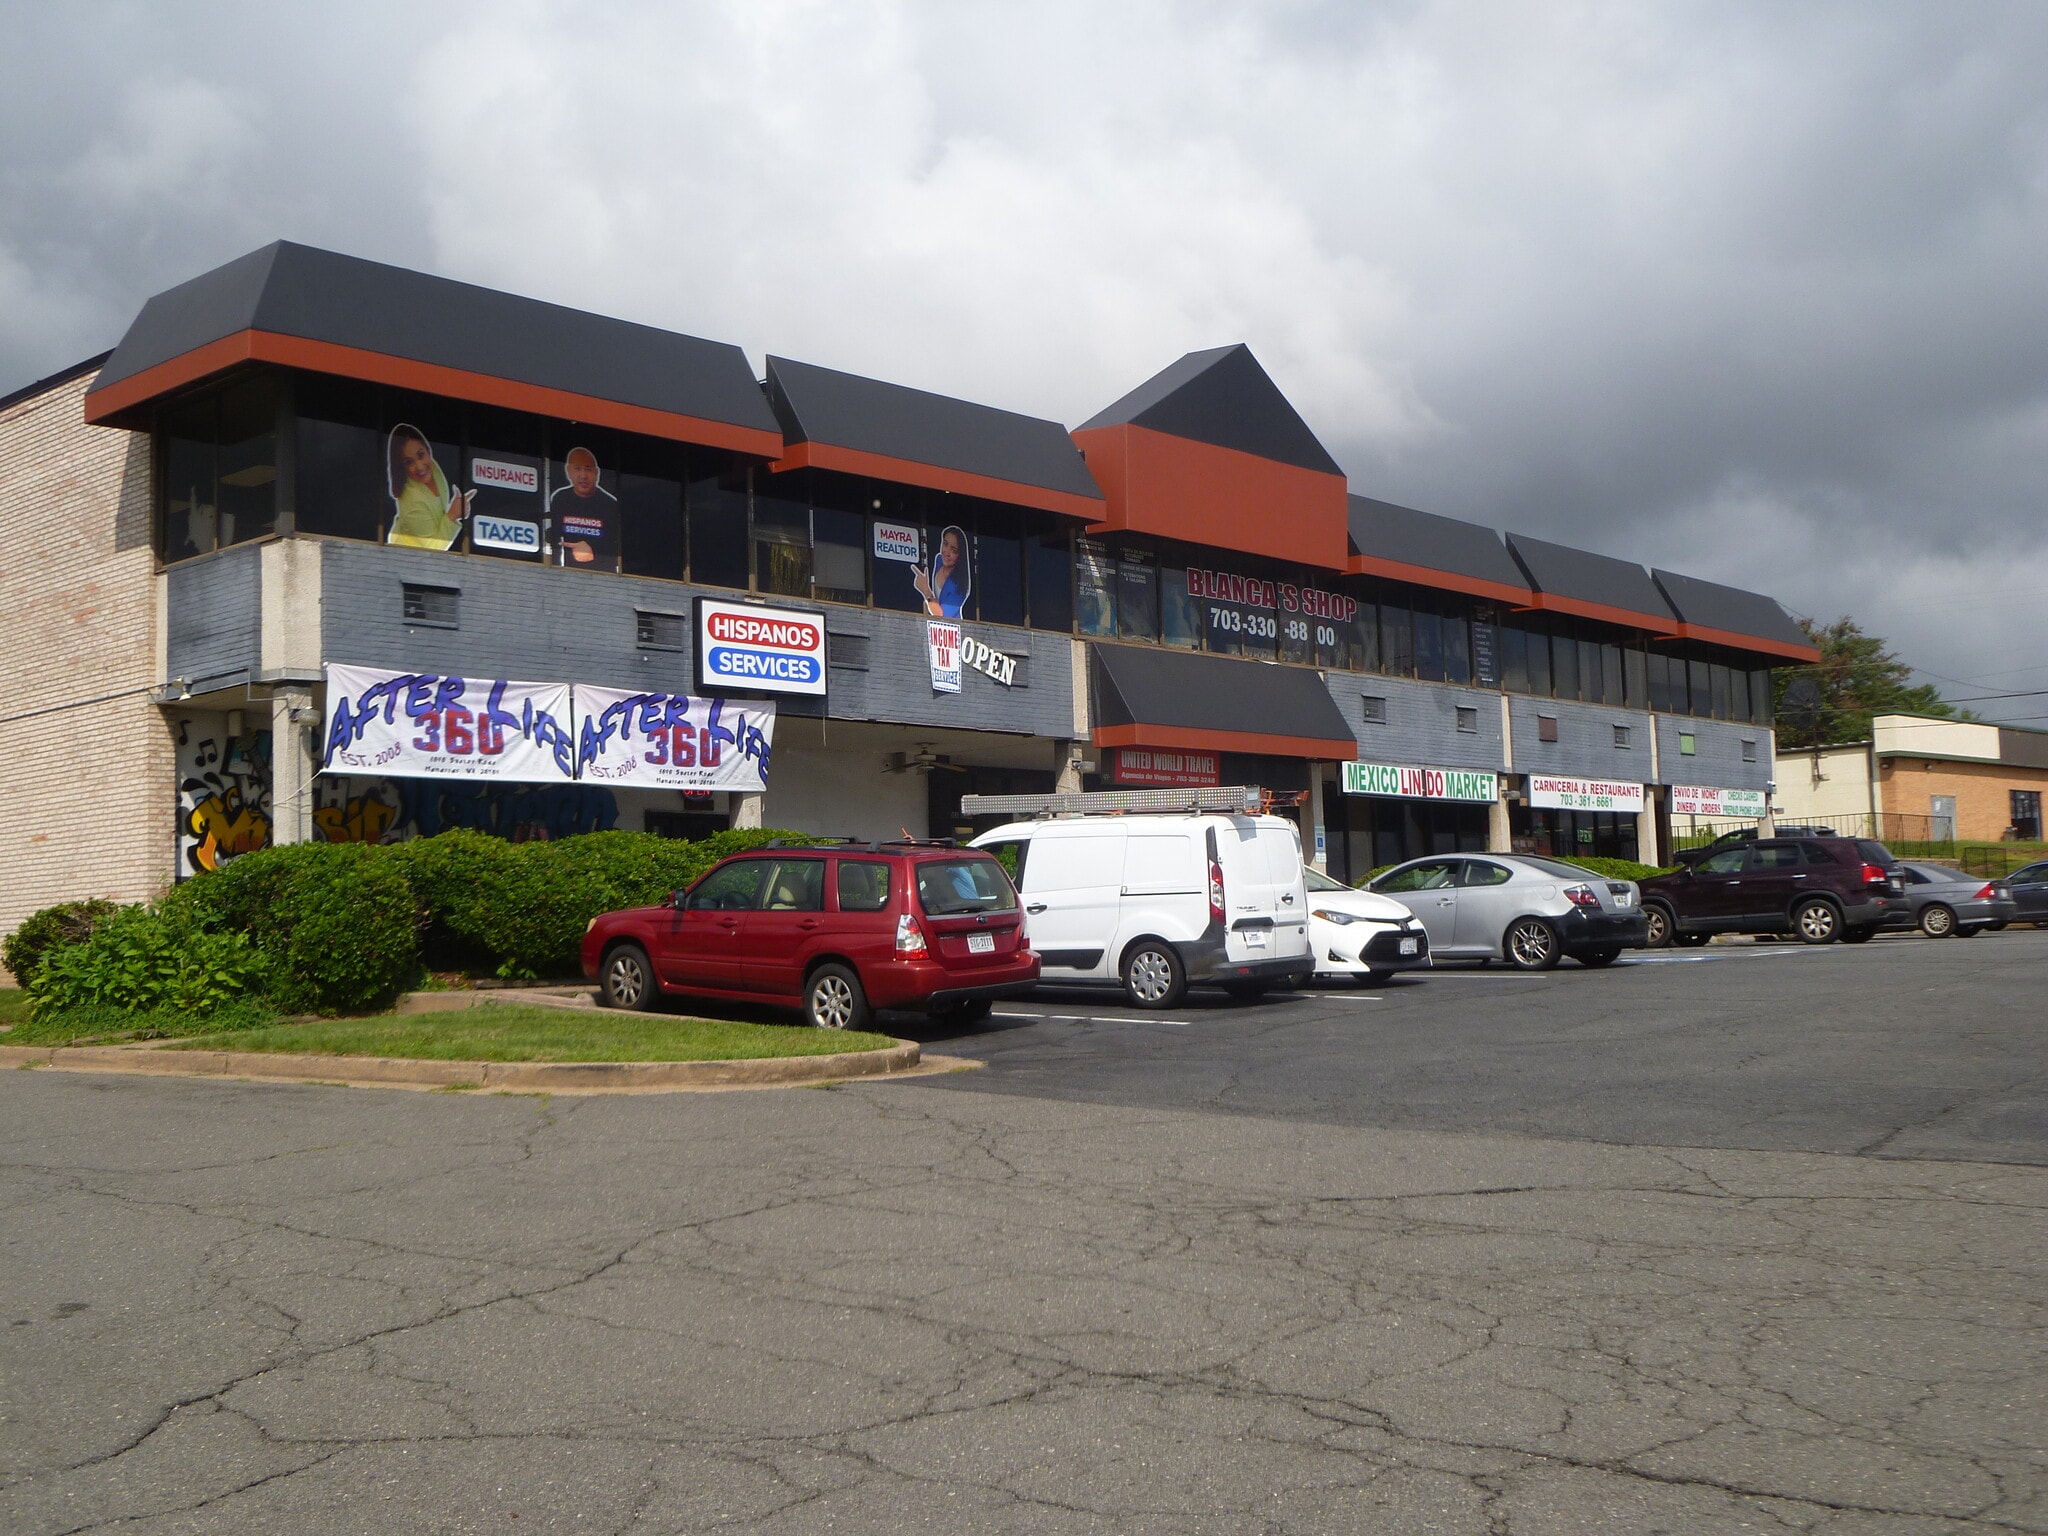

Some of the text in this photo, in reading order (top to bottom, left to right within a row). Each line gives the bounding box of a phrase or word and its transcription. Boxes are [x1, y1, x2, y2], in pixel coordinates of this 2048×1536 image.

[475, 464, 534, 486] INSURANCE
[478, 521, 534, 545] TAXES
[563, 516, 602, 527] HISPANOS
[565, 525, 600, 536] SERVICES
[880, 529, 912, 543] MAYRA
[876, 542, 917, 557] REALTOR
[1187, 567, 1357, 623] BLANCA'S SHOP
[714, 617, 814, 647] HISPANOS
[930, 626, 959, 650] INCOME
[720, 652, 811, 680] SERVICES
[938, 648, 950, 668] TAX
[961, 636, 1016, 686] OPEN
[934, 669, 958, 686] SERVICE
[324, 674, 573, 778] AFTER LIFE
[412, 710, 504, 755] 360
[576, 693, 771, 785] AFTER LIFE
[645, 724, 721, 768] 360
[340, 742, 401, 767] EST. 2008
[1121, 750, 1216, 774] UNITED WORLD TRAVEL
[588, 755, 638, 779] EST. 2008
[1348, 764, 1493, 800] MEXICO LINDO MARKET
[1534, 780, 1640, 797] CARNICERIA & RESTAURANTE
[1674, 787, 1698, 798] ENVIO DE
[1560, 794, 1573, 806] 703
[1579, 795, 1590, 806] 361
[1702, 789, 1720, 800] MONEY
[1677, 802, 1696, 812] DINERO
[1701, 802, 1721, 813] ORDERS
